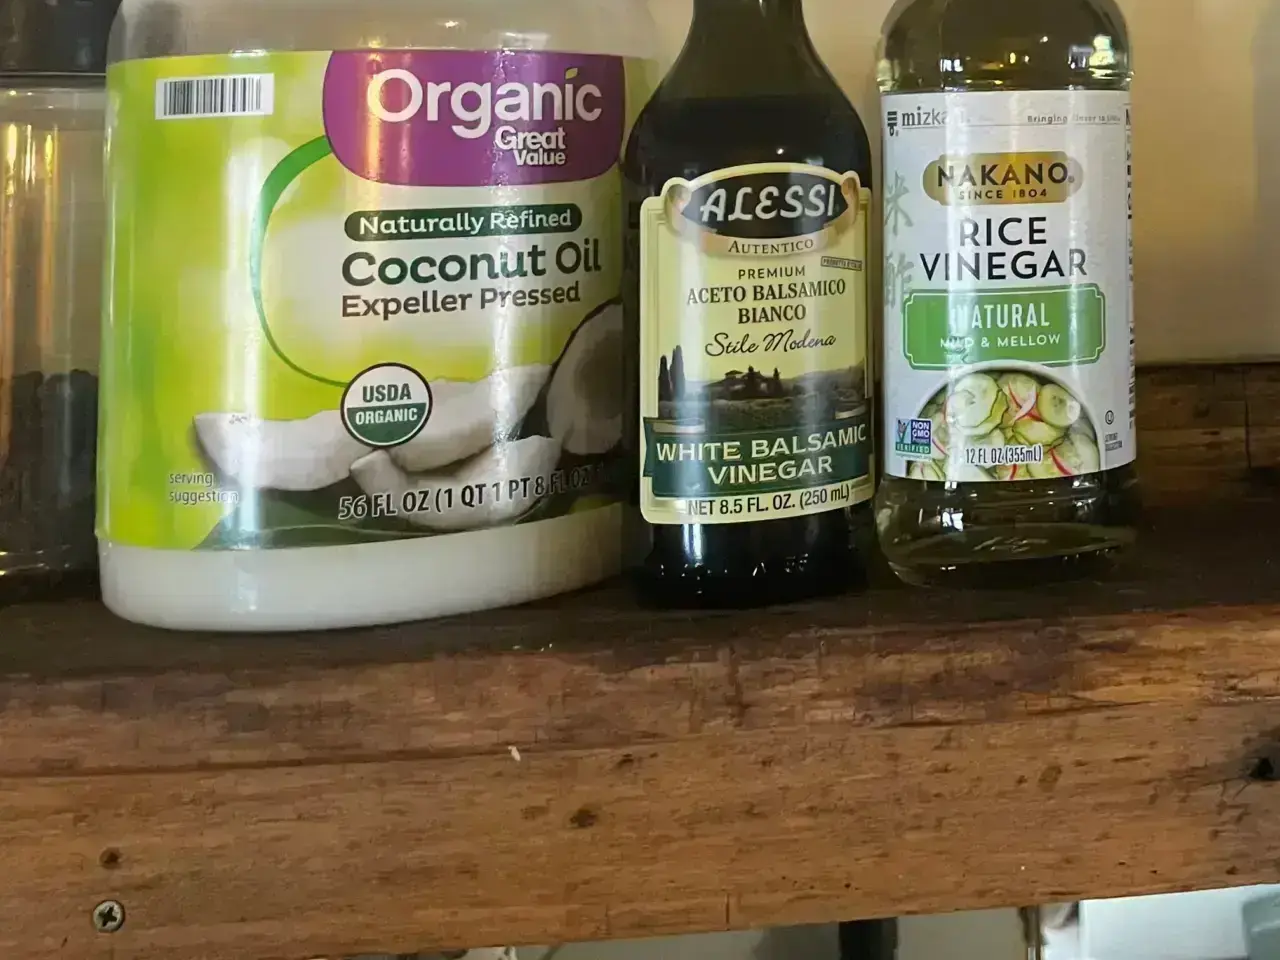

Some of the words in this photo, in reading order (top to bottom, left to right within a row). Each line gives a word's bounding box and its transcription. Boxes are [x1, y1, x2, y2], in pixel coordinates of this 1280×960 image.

[367, 67, 602, 139] Organic
[495, 125, 566, 151] Great
[513, 148, 567, 167] Value
[938, 161, 1069, 187] NAKANO
[700, 184, 836, 222] ALESSI
[957, 190, 1003, 200] SINCE
[1012, 188, 1047, 199] 1804
[359, 212, 485, 235] Naturally
[490, 209, 572, 230] Refined
[960, 217, 1047, 246] RICE
[728, 238, 815, 254] AUTENTICO
[342, 244, 547, 287] Coconut
[556, 238, 602, 274] Oil
[738, 264, 806, 280] PREMIUM
[919, 248, 1088, 281] VINEGAR
[341, 290, 473, 321] Expeller
[480, 281, 581, 310] Pressed
[687, 285, 747, 305] ACETO
[752, 278, 846, 302] BALSAMICO
[738, 304, 807, 325] BIANCO
[705, 331, 760, 357] Stile
[763, 328, 837, 353] Modena
[981, 336, 990, 348] &
[997, 334, 1061, 348] MELLOW
[362, 383, 412, 403] USDA
[355, 408, 418, 425] ORGANIC
[912, 421, 930, 430] NON
[656, 441, 743, 462] WHITE
[751, 424, 867, 458] BALSAMIC
[912, 429, 930, 438] GMO
[965, 448, 976, 463] 12
[978, 448, 988, 463] FL
[991, 447, 1003, 463] OZ
[169, 471, 214, 488] serving
[708, 455, 833, 485] VINEGAR
[169, 489, 239, 506] suggestion
[338, 495, 368, 520] 56
[371, 492, 397, 517] FL
[401, 490, 430, 514] OZ
[435, 486, 453, 514] (1
[460, 482, 487, 509] QT
[492, 481, 501, 504] 1
[508, 477, 531, 500] PT
[534, 475, 545, 497] 8
[688, 498, 716, 516] NET
[720, 498, 743, 515] 8.5
[747, 496, 769, 513] FL.
[772, 493, 796, 511] OZ.
[799, 487, 828, 510] (250
